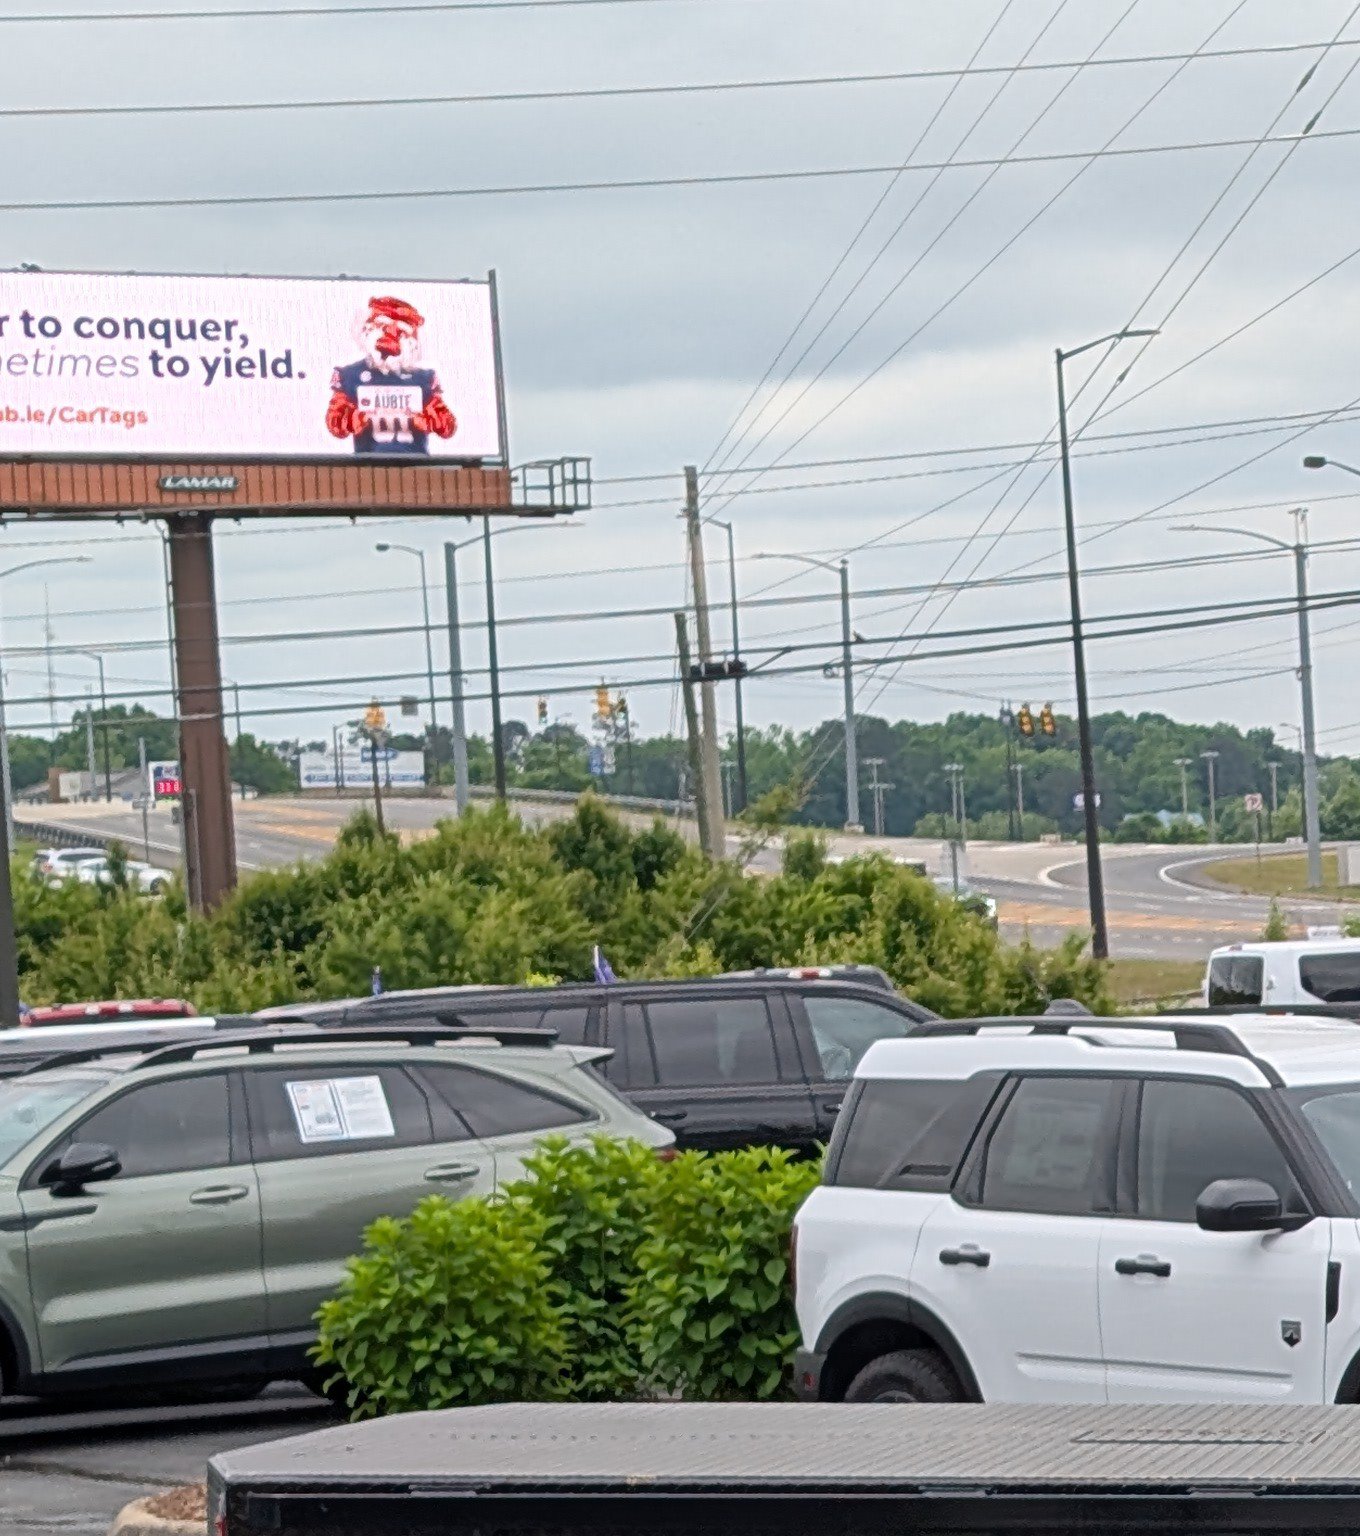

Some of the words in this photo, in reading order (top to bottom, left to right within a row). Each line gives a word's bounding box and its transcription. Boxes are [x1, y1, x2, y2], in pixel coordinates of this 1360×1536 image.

[20, 310, 62, 338] to
[73, 315, 249, 349] conquer,
[0, 345, 139, 378] etimes
[149, 349, 190, 378] to
[200, 347, 306, 387] yield.
[164, 475, 235, 489] LAMAR
